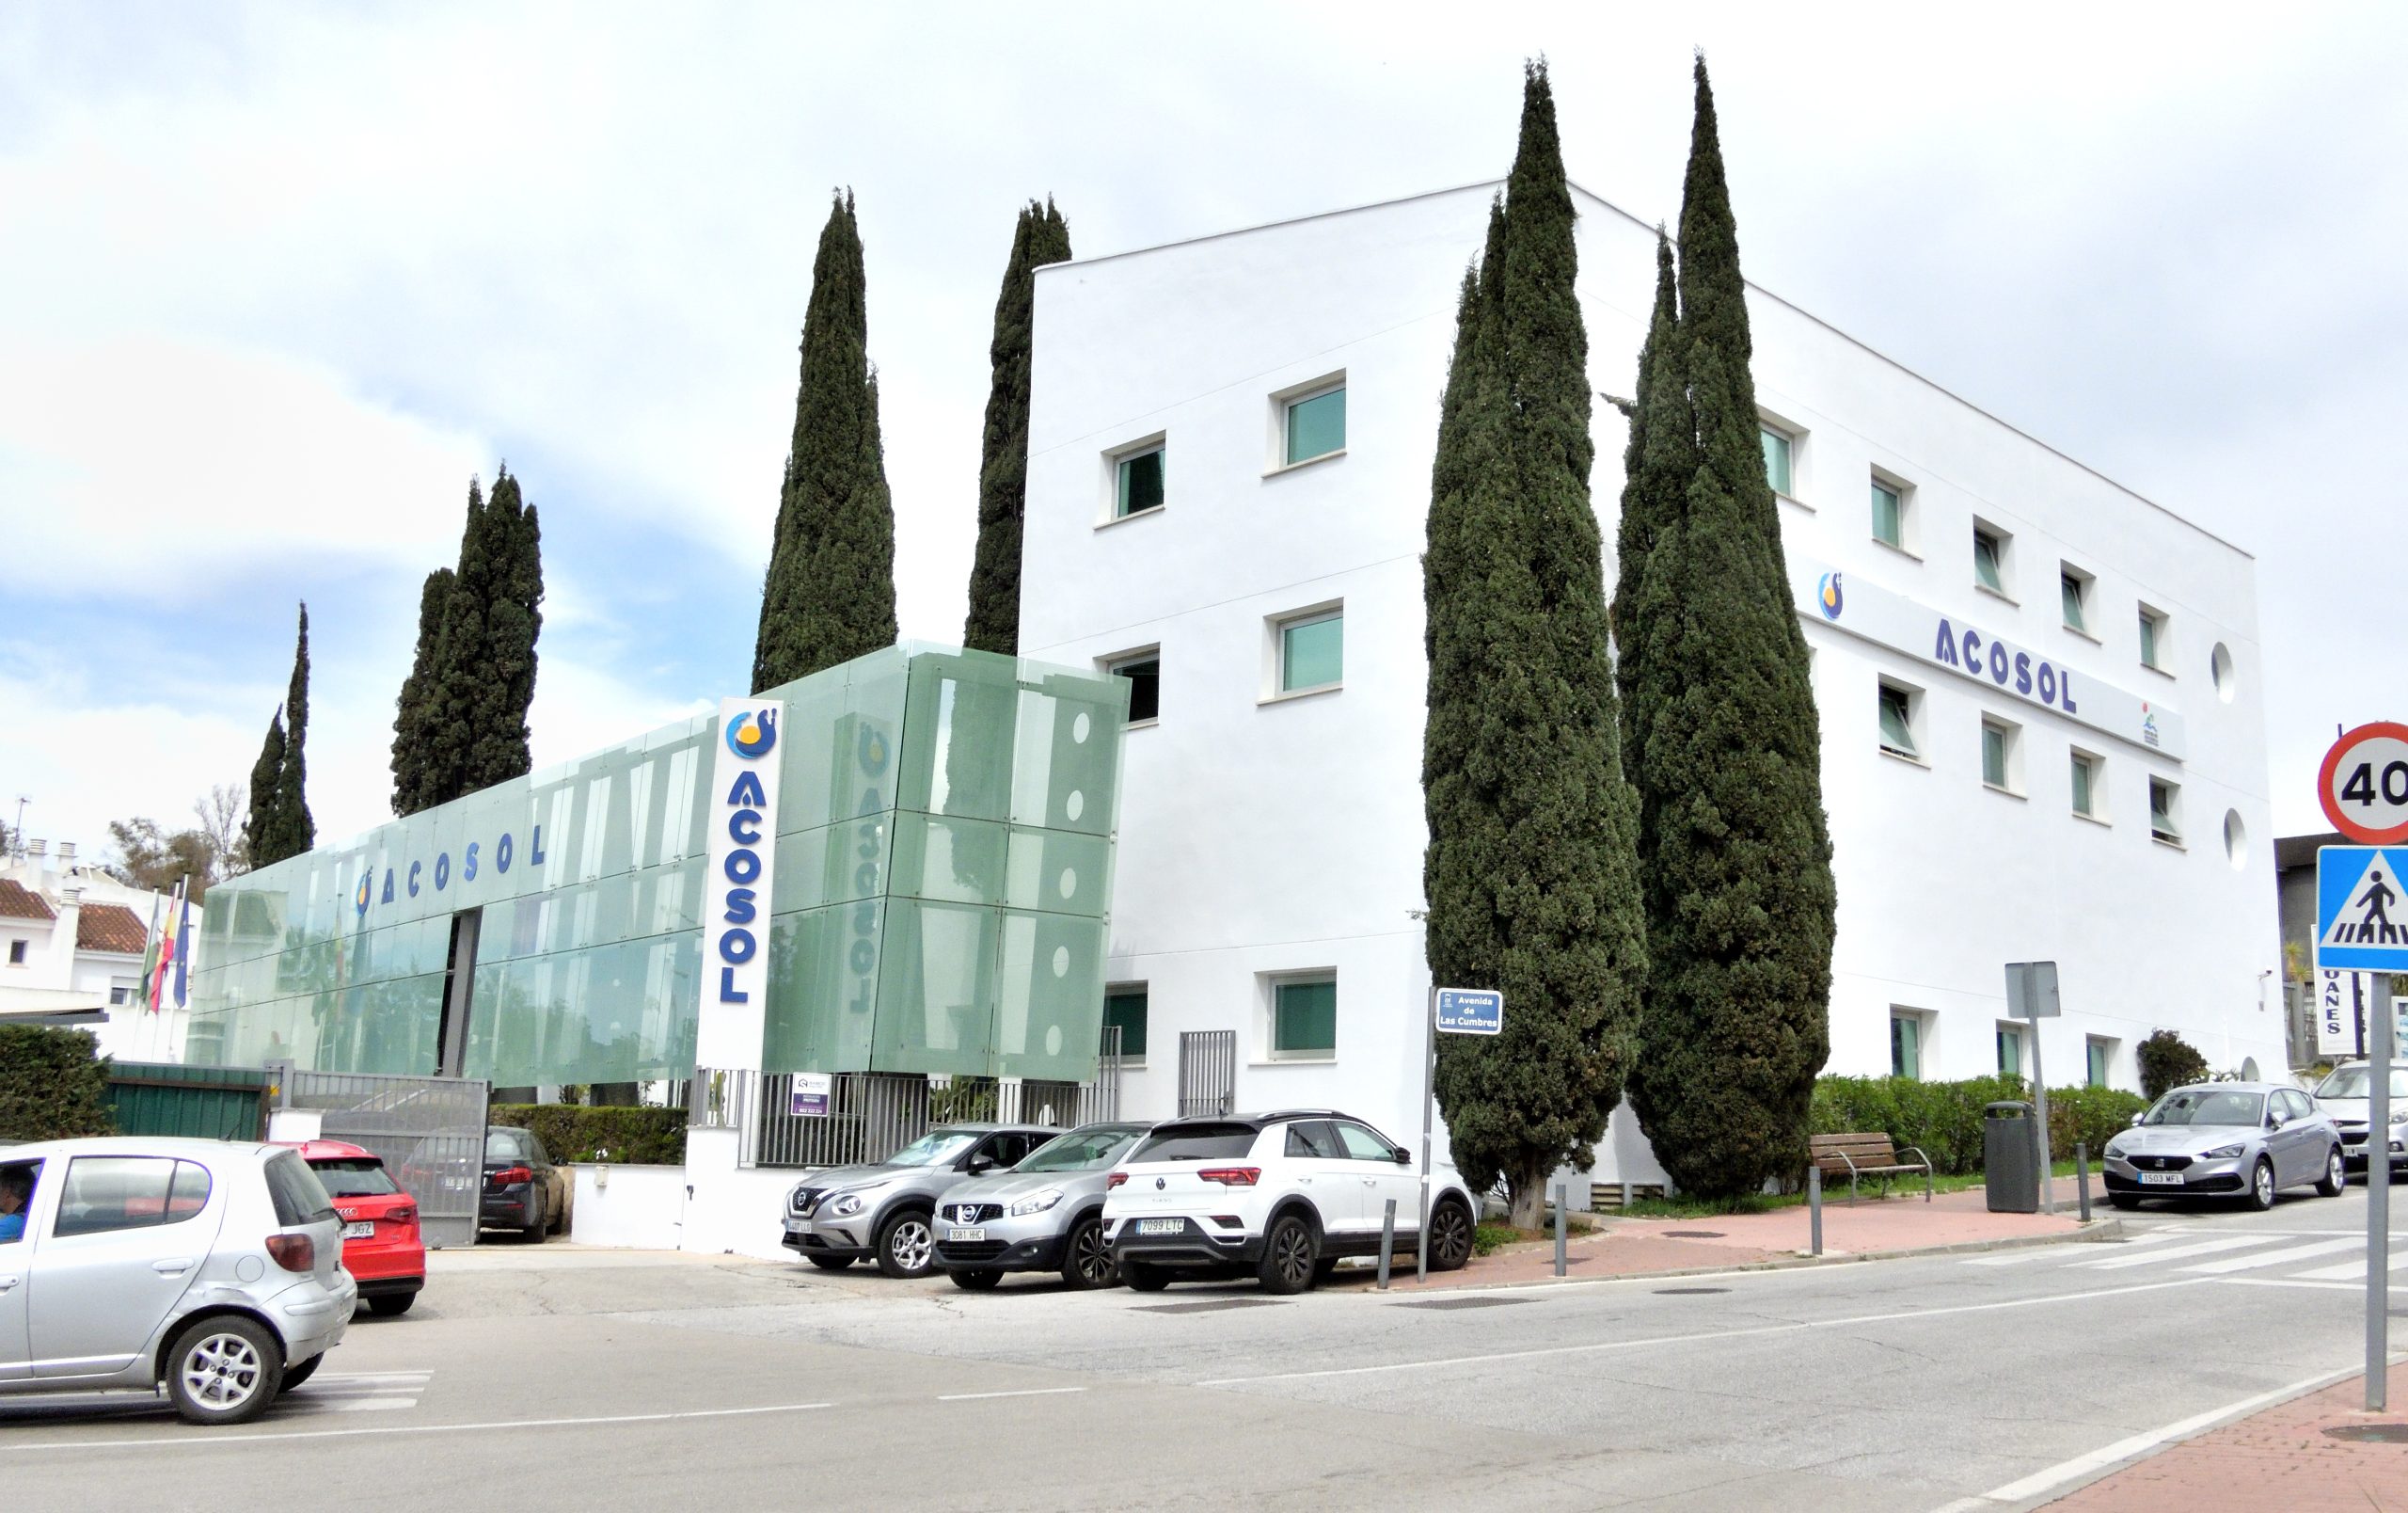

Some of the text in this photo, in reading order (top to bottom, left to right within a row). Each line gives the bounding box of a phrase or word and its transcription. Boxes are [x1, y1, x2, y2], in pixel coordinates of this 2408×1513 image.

[1936, 618, 2077, 714] ACOSOL
[2341, 760, 2408, 806] 40
[381, 824, 545, 905] ACOSOL
[719, 771, 767, 1003] ACOSOL
[1458, 996, 1493, 1006] Avenida
[1464, 1007, 1475, 1015] de
[1440, 1016, 1497, 1027] Las Cumbres
[2145, 1174, 2163, 1183] 1503
[352, 1223, 372, 1234] JGZ
[1142, 1219, 1183, 1231] 7099 LTC
